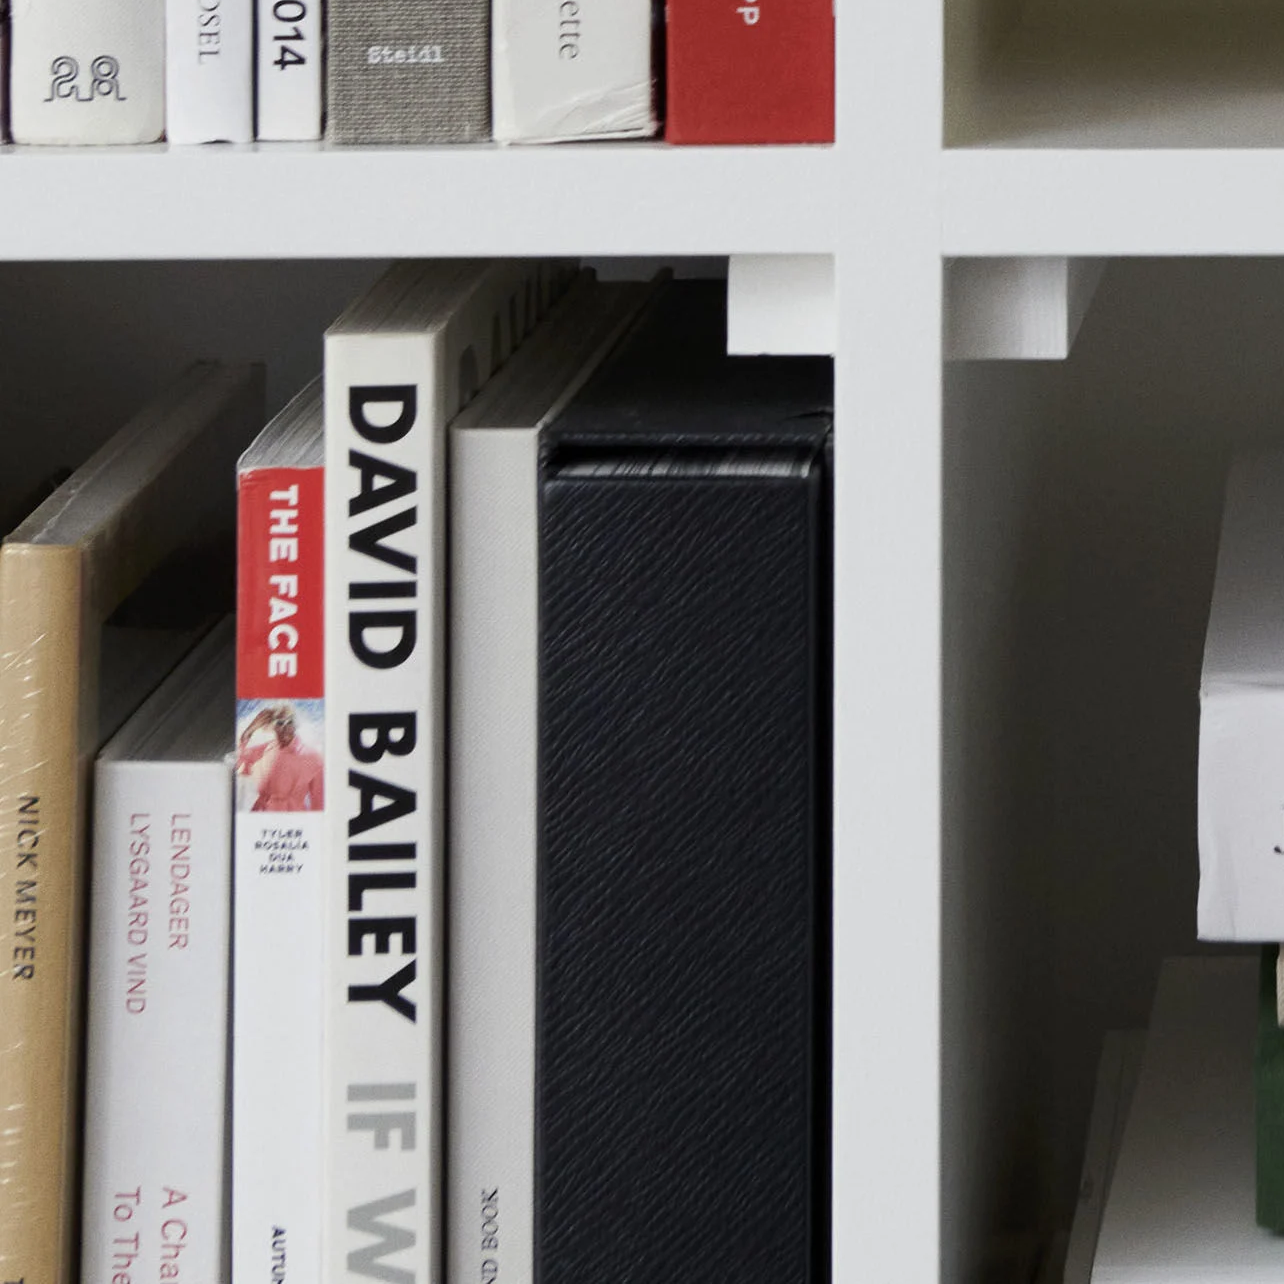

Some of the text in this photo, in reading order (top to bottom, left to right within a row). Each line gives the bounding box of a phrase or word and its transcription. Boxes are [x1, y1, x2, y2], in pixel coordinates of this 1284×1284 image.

[43, 54, 127, 103] 28
[267, 484, 300, 678] THE FACE
[347, 383, 418, 1150] DAVID BAILEY IF
[12, 796, 39, 980] NICK MEYER
[125, 812, 151, 1015] LYSGAARD VIND
[168, 814, 192, 949] LENDAGER
